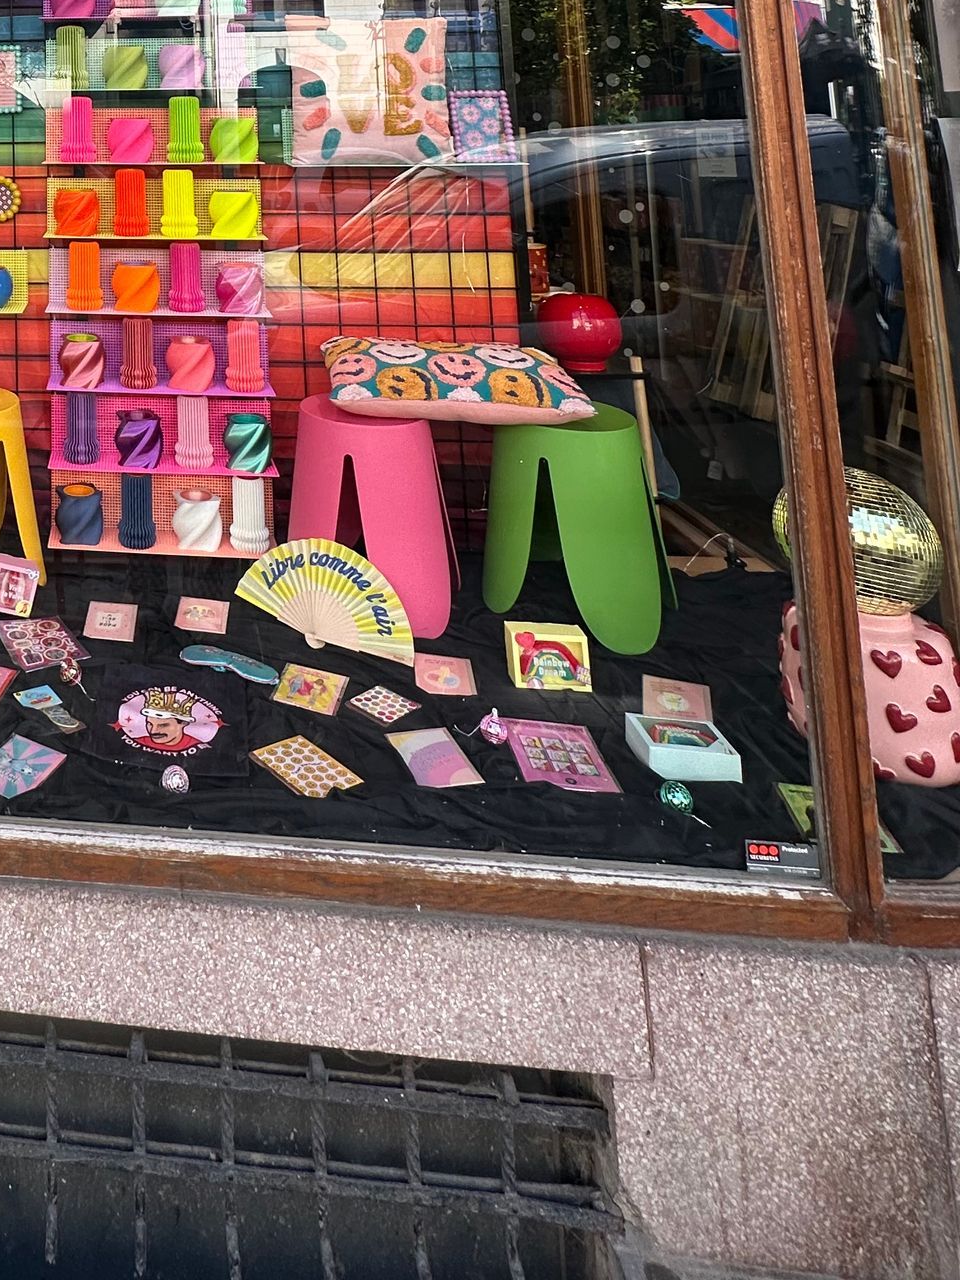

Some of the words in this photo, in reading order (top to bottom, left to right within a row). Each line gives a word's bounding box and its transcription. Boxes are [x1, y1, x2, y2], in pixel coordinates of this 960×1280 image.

[260, 553, 305, 590] Libre
[309, 552, 372, 591] comme
[366, 592, 396, 637] l'air
[533, 656, 571, 668] Rainbow
[121, 690, 140, 702] YOU
[179, 688, 223, 716] ANYTHING
[121, 734, 141, 749] YOU
[142, 746, 179, 757] WANT
[180, 747, 197, 757] TO
